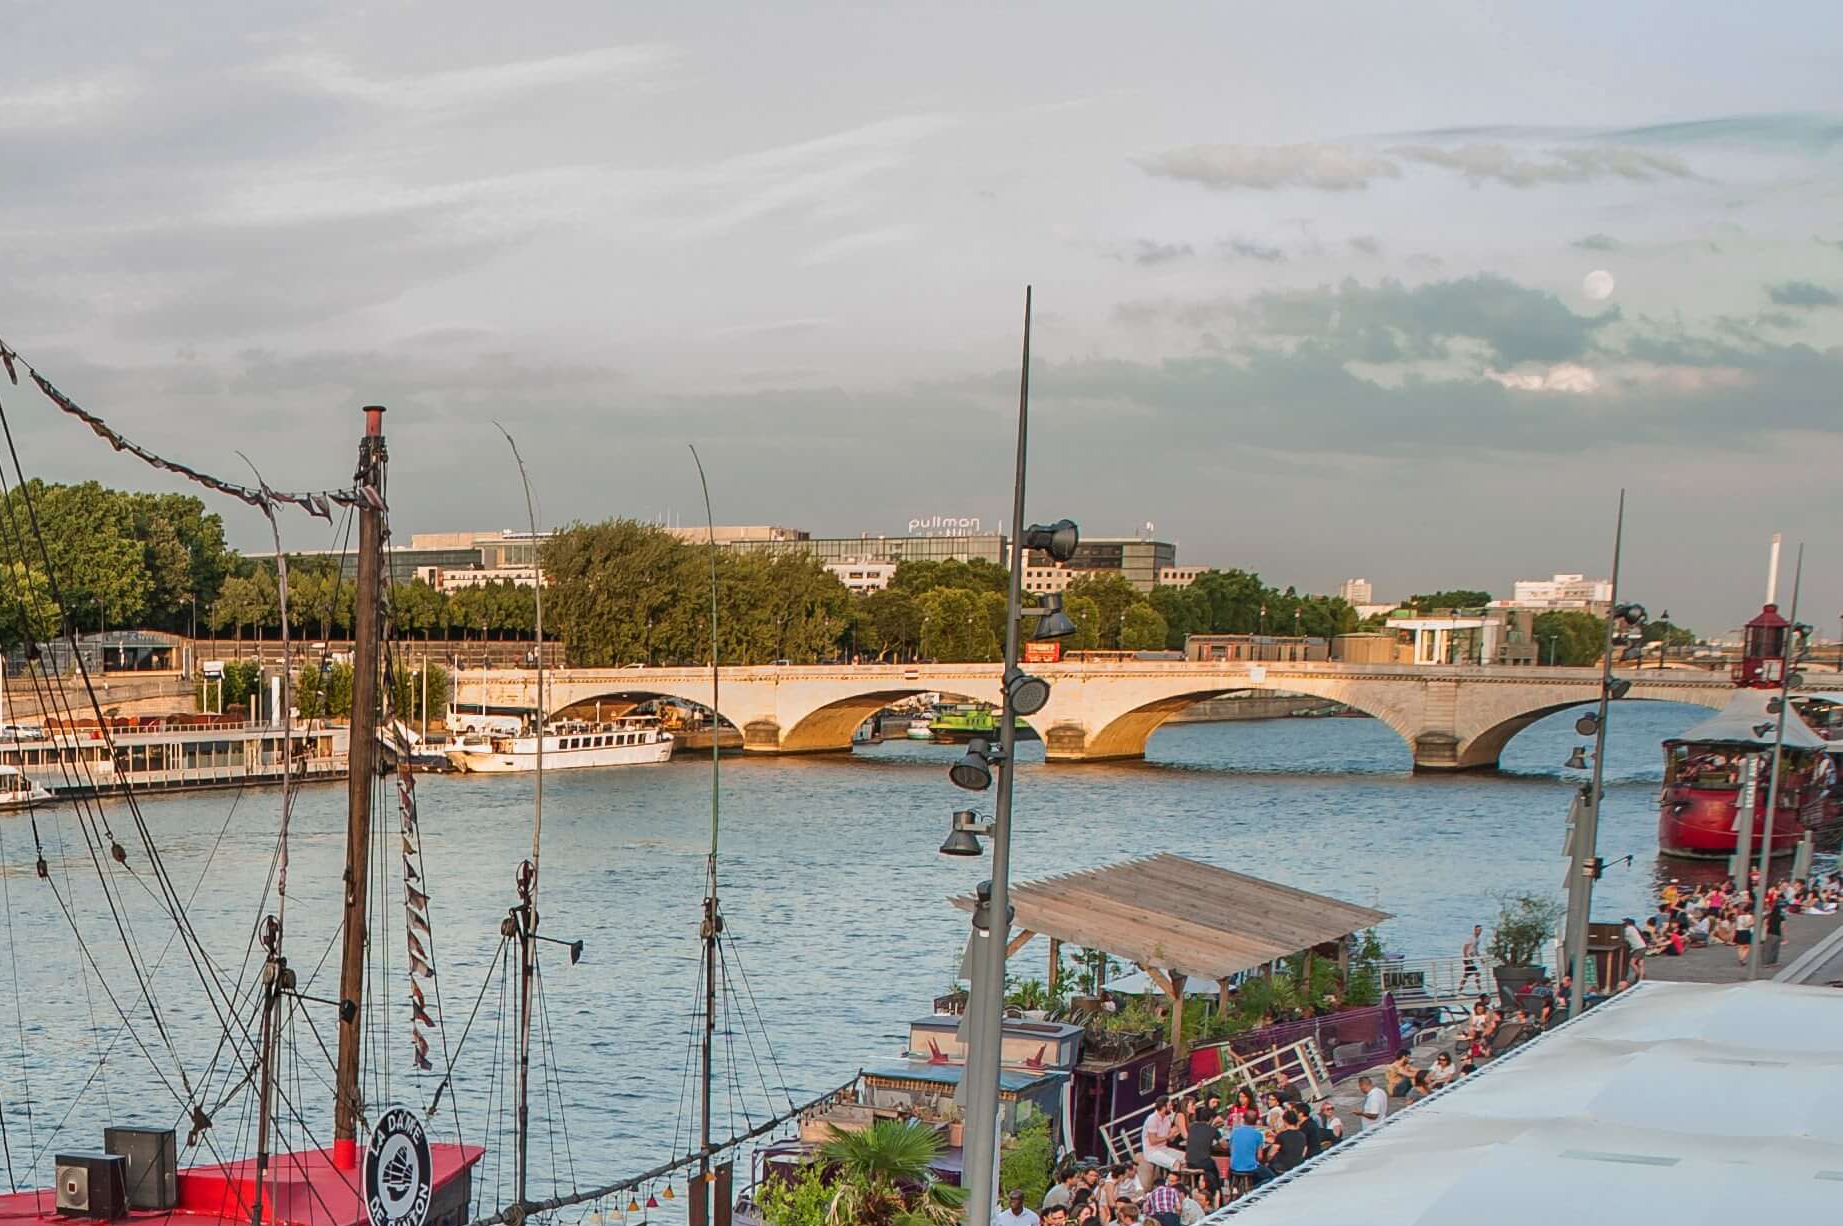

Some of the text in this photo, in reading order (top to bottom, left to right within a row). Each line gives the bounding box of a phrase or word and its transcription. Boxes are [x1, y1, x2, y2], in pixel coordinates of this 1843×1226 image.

[908, 515, 980, 533] pullman
[370, 1110, 422, 1157] LA DAME
[369, 1196, 386, 1226] DE
